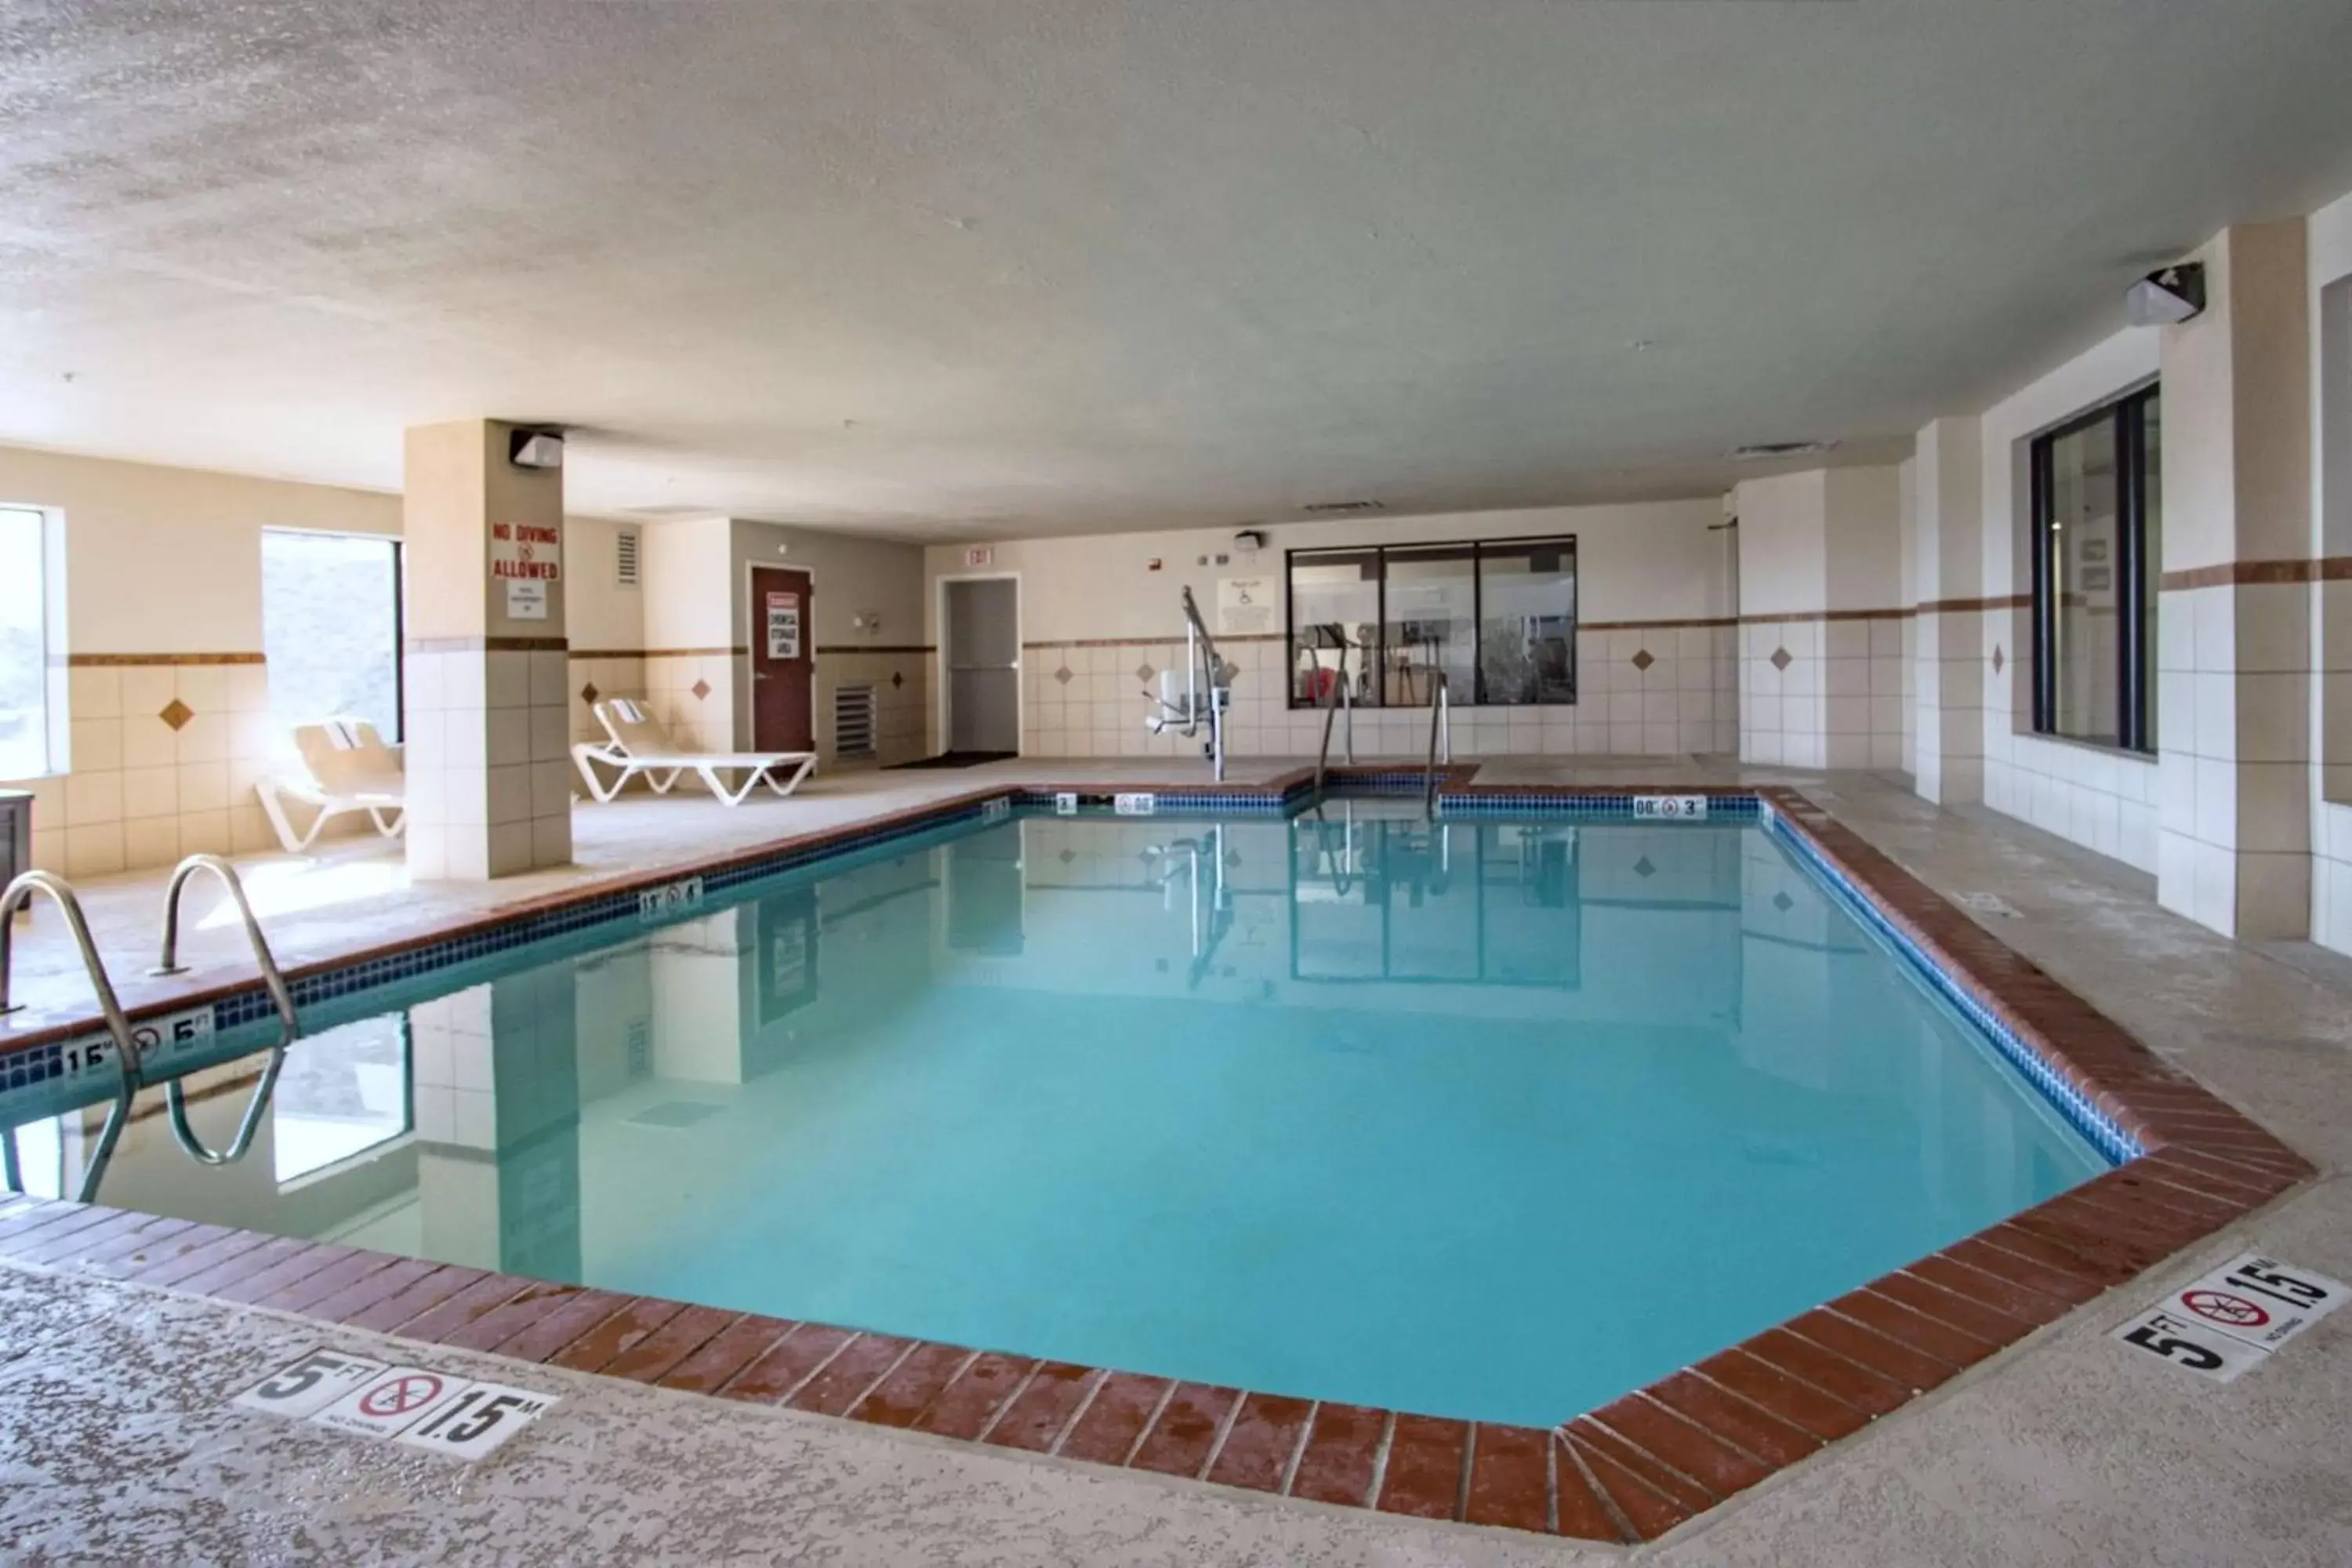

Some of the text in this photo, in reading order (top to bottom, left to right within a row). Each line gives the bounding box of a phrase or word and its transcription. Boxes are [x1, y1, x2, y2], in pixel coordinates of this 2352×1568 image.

[493, 524, 557, 543] NO DIVING
[494, 559, 557, 579] ALLOWED
[1685, 800, 1695, 815] 3
